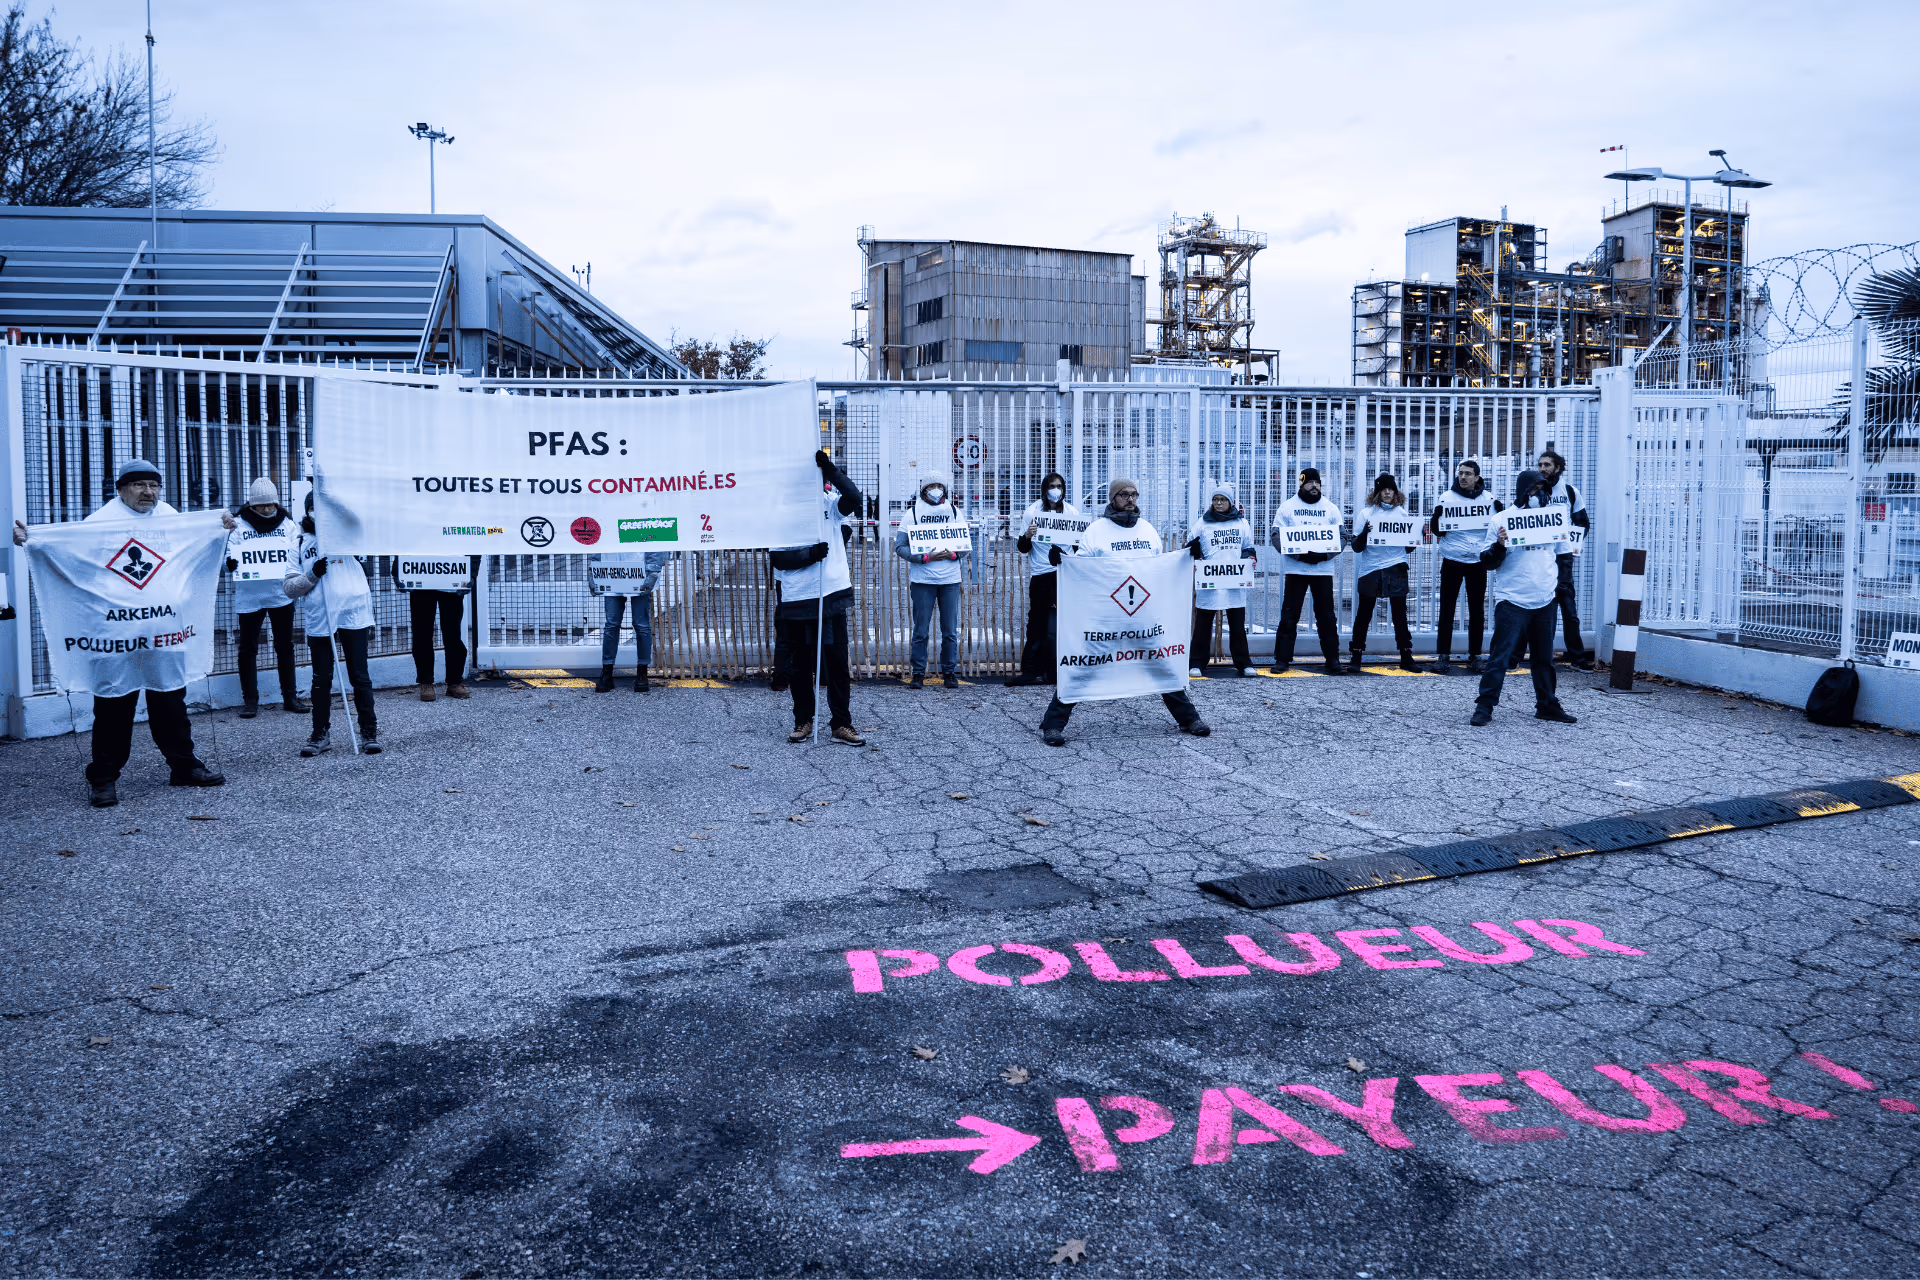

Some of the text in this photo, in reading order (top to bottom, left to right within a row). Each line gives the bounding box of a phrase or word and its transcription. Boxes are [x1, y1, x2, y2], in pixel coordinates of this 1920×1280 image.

[528, 431, 610, 456] PFAS
[412, 470, 737, 495] TOUTES ET TOUS CONTAMINÉ.ES
[920, 514, 951, 523] GRIGNY
[1293, 508, 1327, 518] MORNANT
[1444, 504, 1491, 518] MILLERY
[620, 520, 676, 531] GREENPEACE
[1378, 521, 1414, 534] IRIGNY
[1507, 512, 1563, 531] BRIGNAIS
[910, 525, 968, 541] PIERRE BÉNITE
[1213, 528, 1240, 538] SOUCIEU
[1286, 529, 1334, 542] VOURLES
[1110, 537, 1152, 552] PIERRE BÉNITE
[241, 548, 290, 565] RIVER
[402, 561, 467, 575] CHAUSSAN
[592, 567, 645, 580] SAINT-GENIS-LAVAL
[1203, 564, 1245, 577] CHARLY
[106, 603, 177, 621] ARKEMA,
[64, 624, 197, 654] POLLUEUR ETERNEL
[1083, 623, 1165, 642] TERRE POLLUÉE,
[1059, 643, 1185, 667] ARKEMA DOIT PAYER
[846, 917, 1647, 994] POLLUEUR
